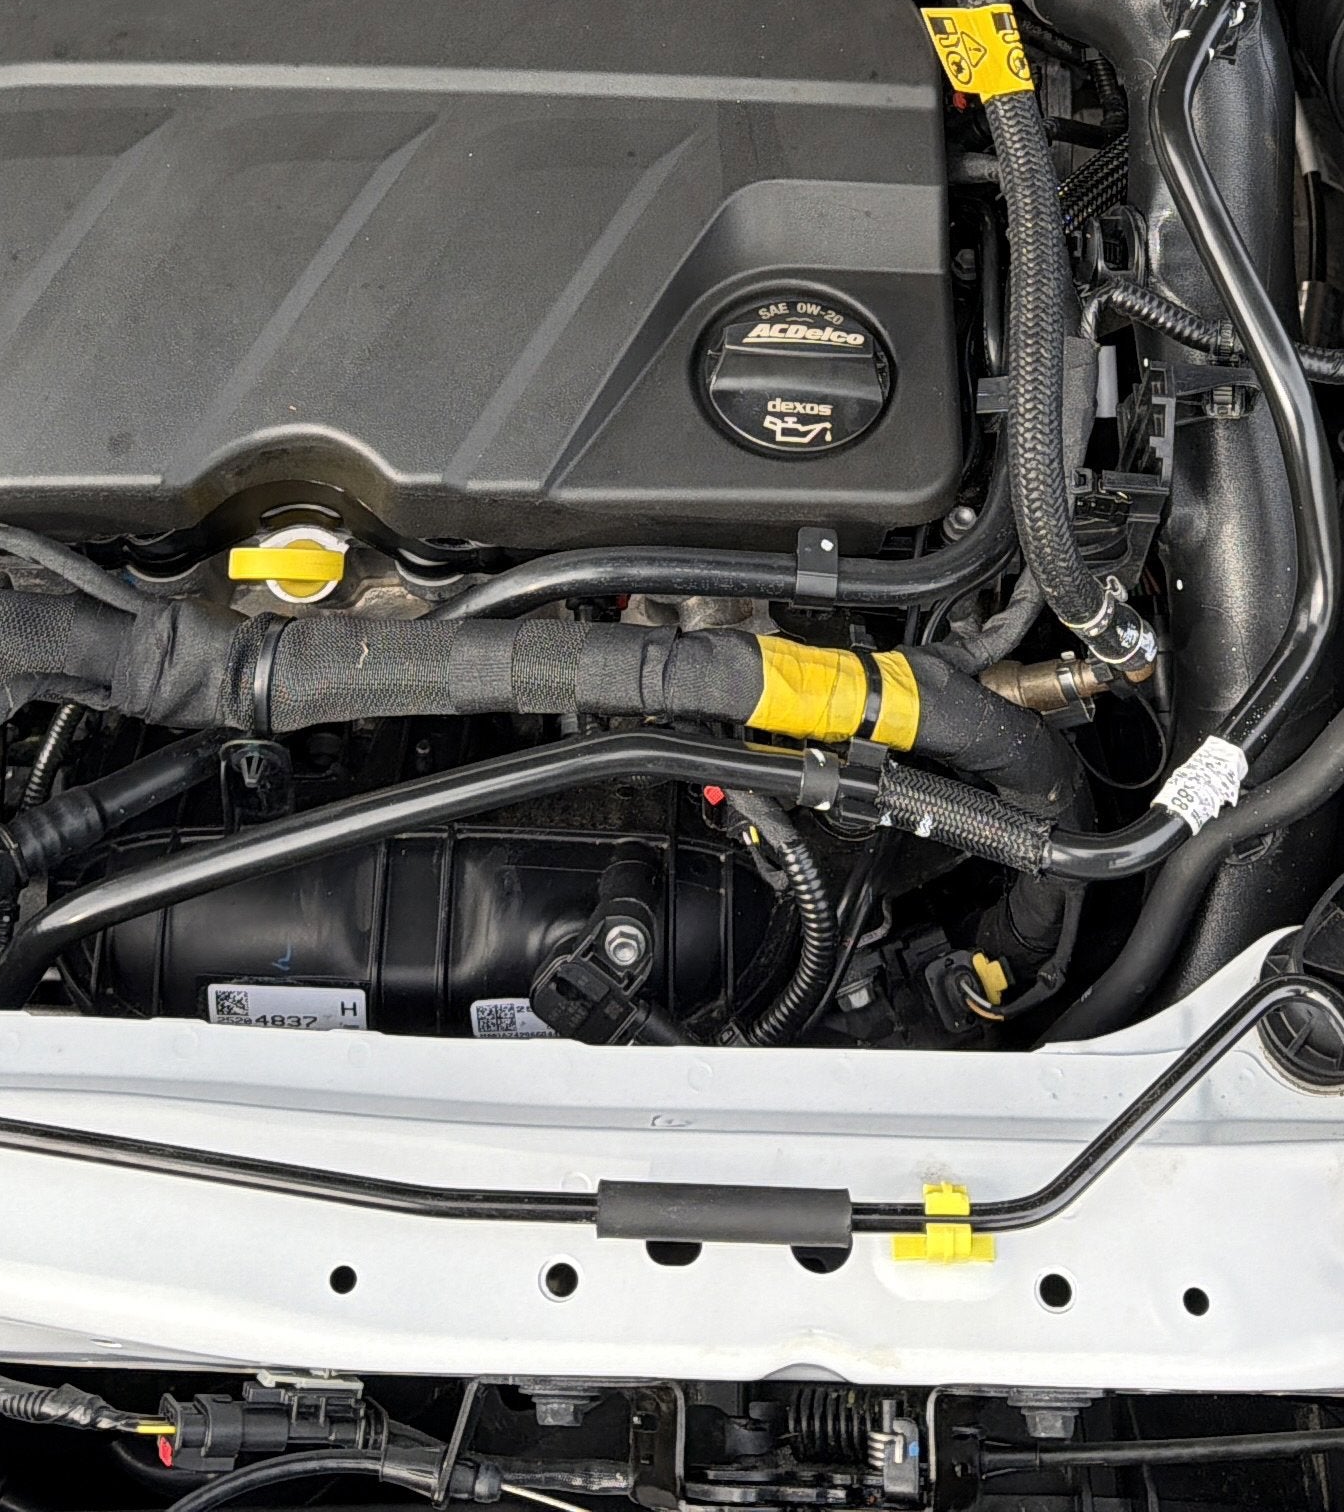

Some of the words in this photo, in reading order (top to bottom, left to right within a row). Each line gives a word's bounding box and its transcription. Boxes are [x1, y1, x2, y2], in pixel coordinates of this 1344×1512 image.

[758, 302, 789, 320] SAE
[746, 323, 865, 346] ACDelco
[767, 397, 833, 416] dexos
[340, 1000, 358, 1018] H
[256, 1014, 318, 1029] 4837
